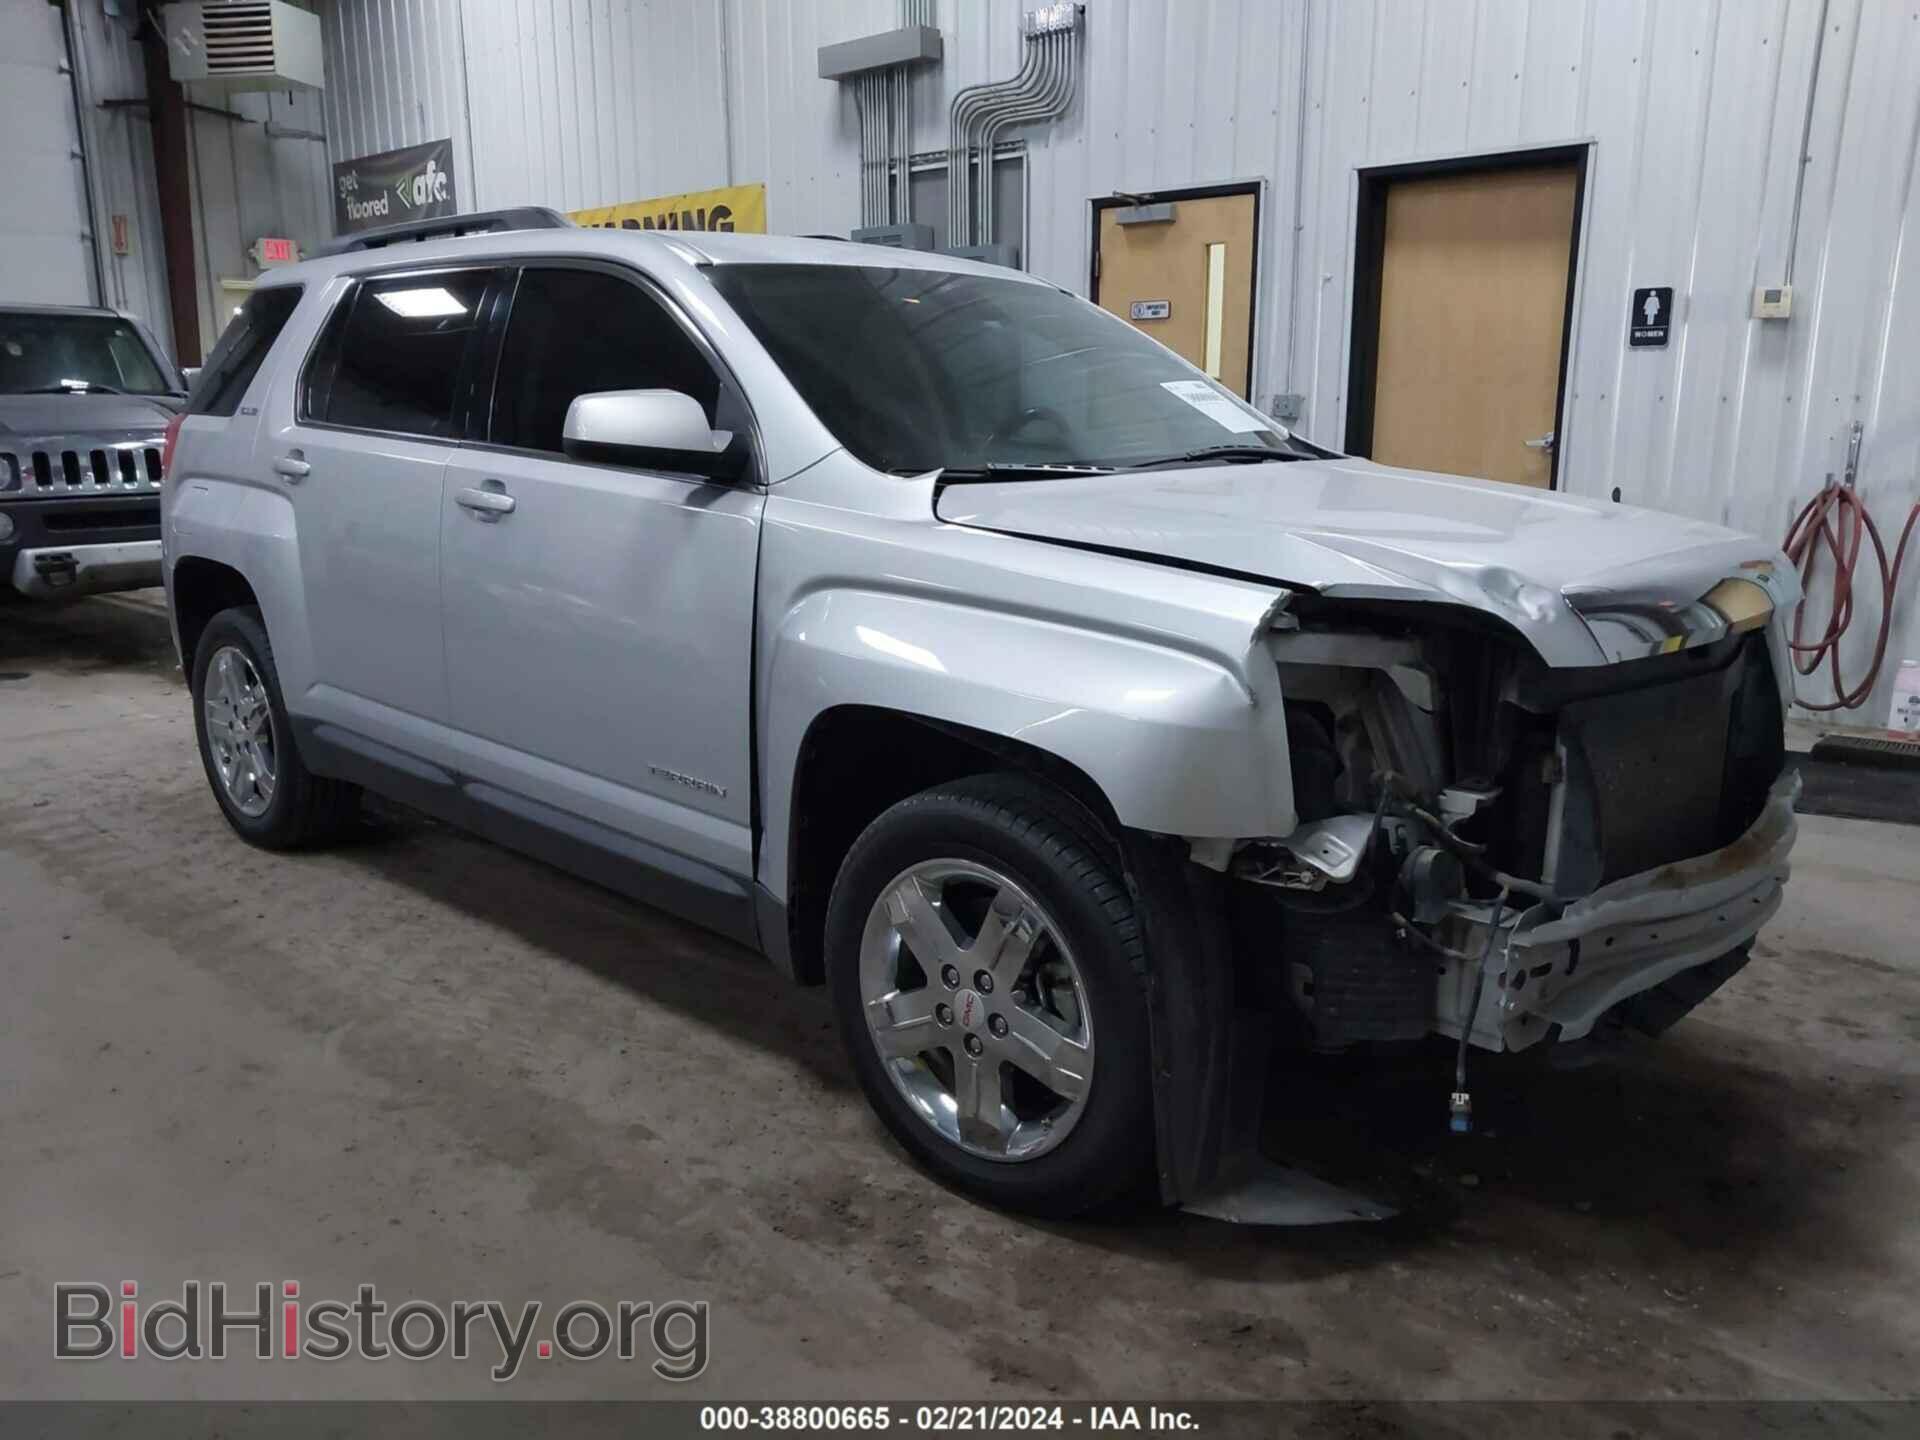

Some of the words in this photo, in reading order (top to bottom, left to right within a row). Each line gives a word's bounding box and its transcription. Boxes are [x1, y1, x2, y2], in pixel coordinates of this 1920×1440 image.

[339, 169, 358, 199] get
[347, 190, 389, 220] floored
[581, 204, 735, 233] NING
[1634, 330, 1664, 338] WOMEN
[962, 992, 975, 1027] GMC
